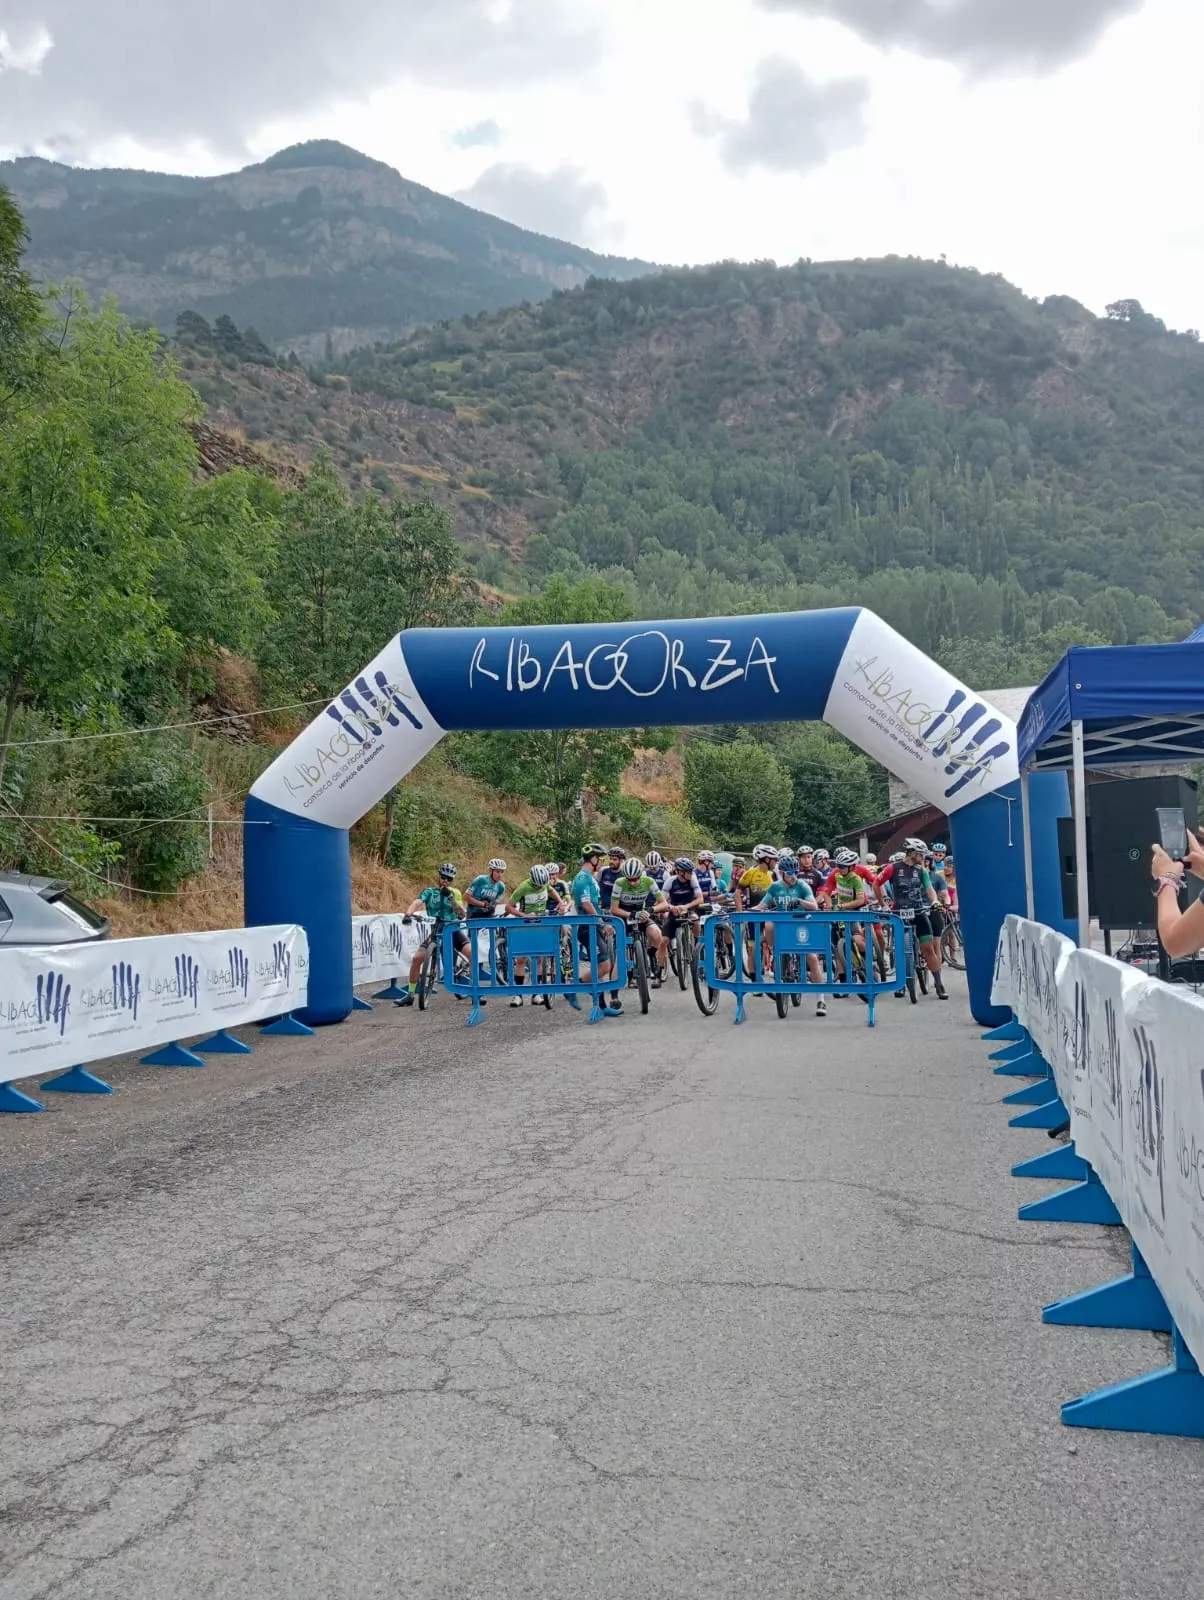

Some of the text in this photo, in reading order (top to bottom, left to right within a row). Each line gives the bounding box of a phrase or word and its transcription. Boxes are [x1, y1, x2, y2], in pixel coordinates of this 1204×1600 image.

[469, 629, 780, 697] RIBAGORZA
[843, 682, 876, 710] comarca
[303, 780, 332, 808] comarca
